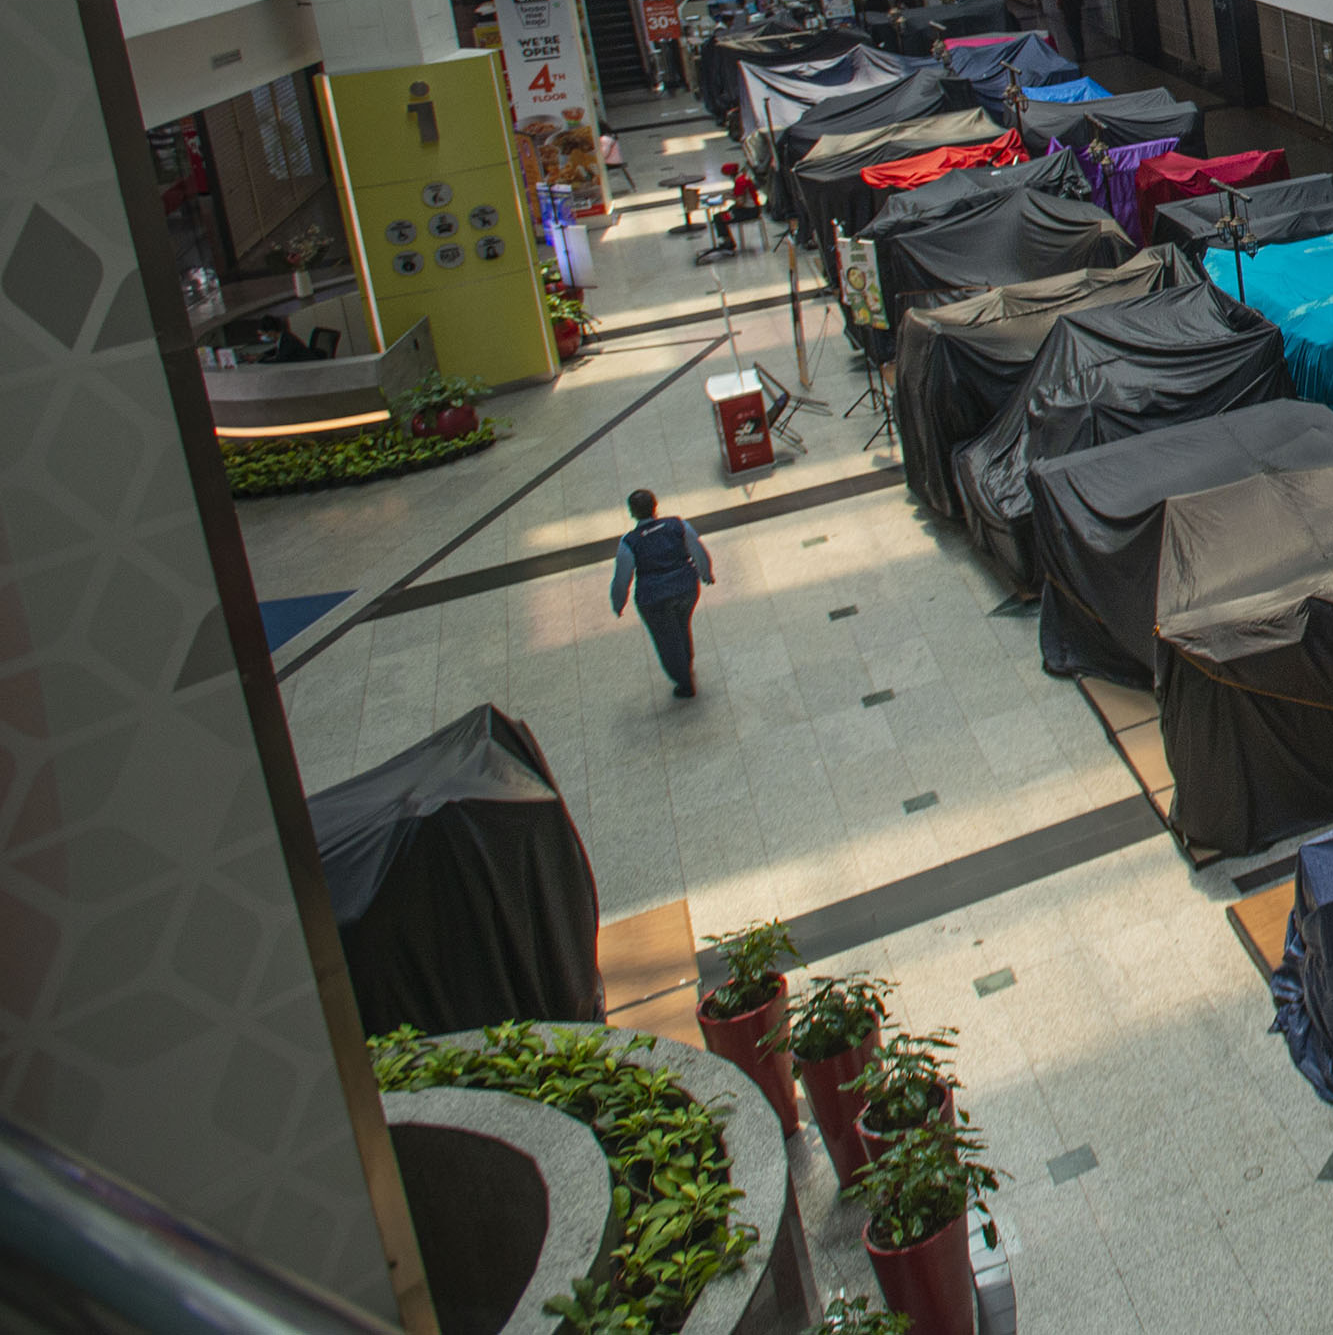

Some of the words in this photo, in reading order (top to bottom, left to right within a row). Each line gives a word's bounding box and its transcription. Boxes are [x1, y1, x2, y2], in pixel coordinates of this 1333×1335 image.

[647, 16, 679, 30] 30%
[519, 35, 560, 48] WE'RE
[522, 45, 560, 58] OPEN
[533, 92, 567, 103] FLOOR
